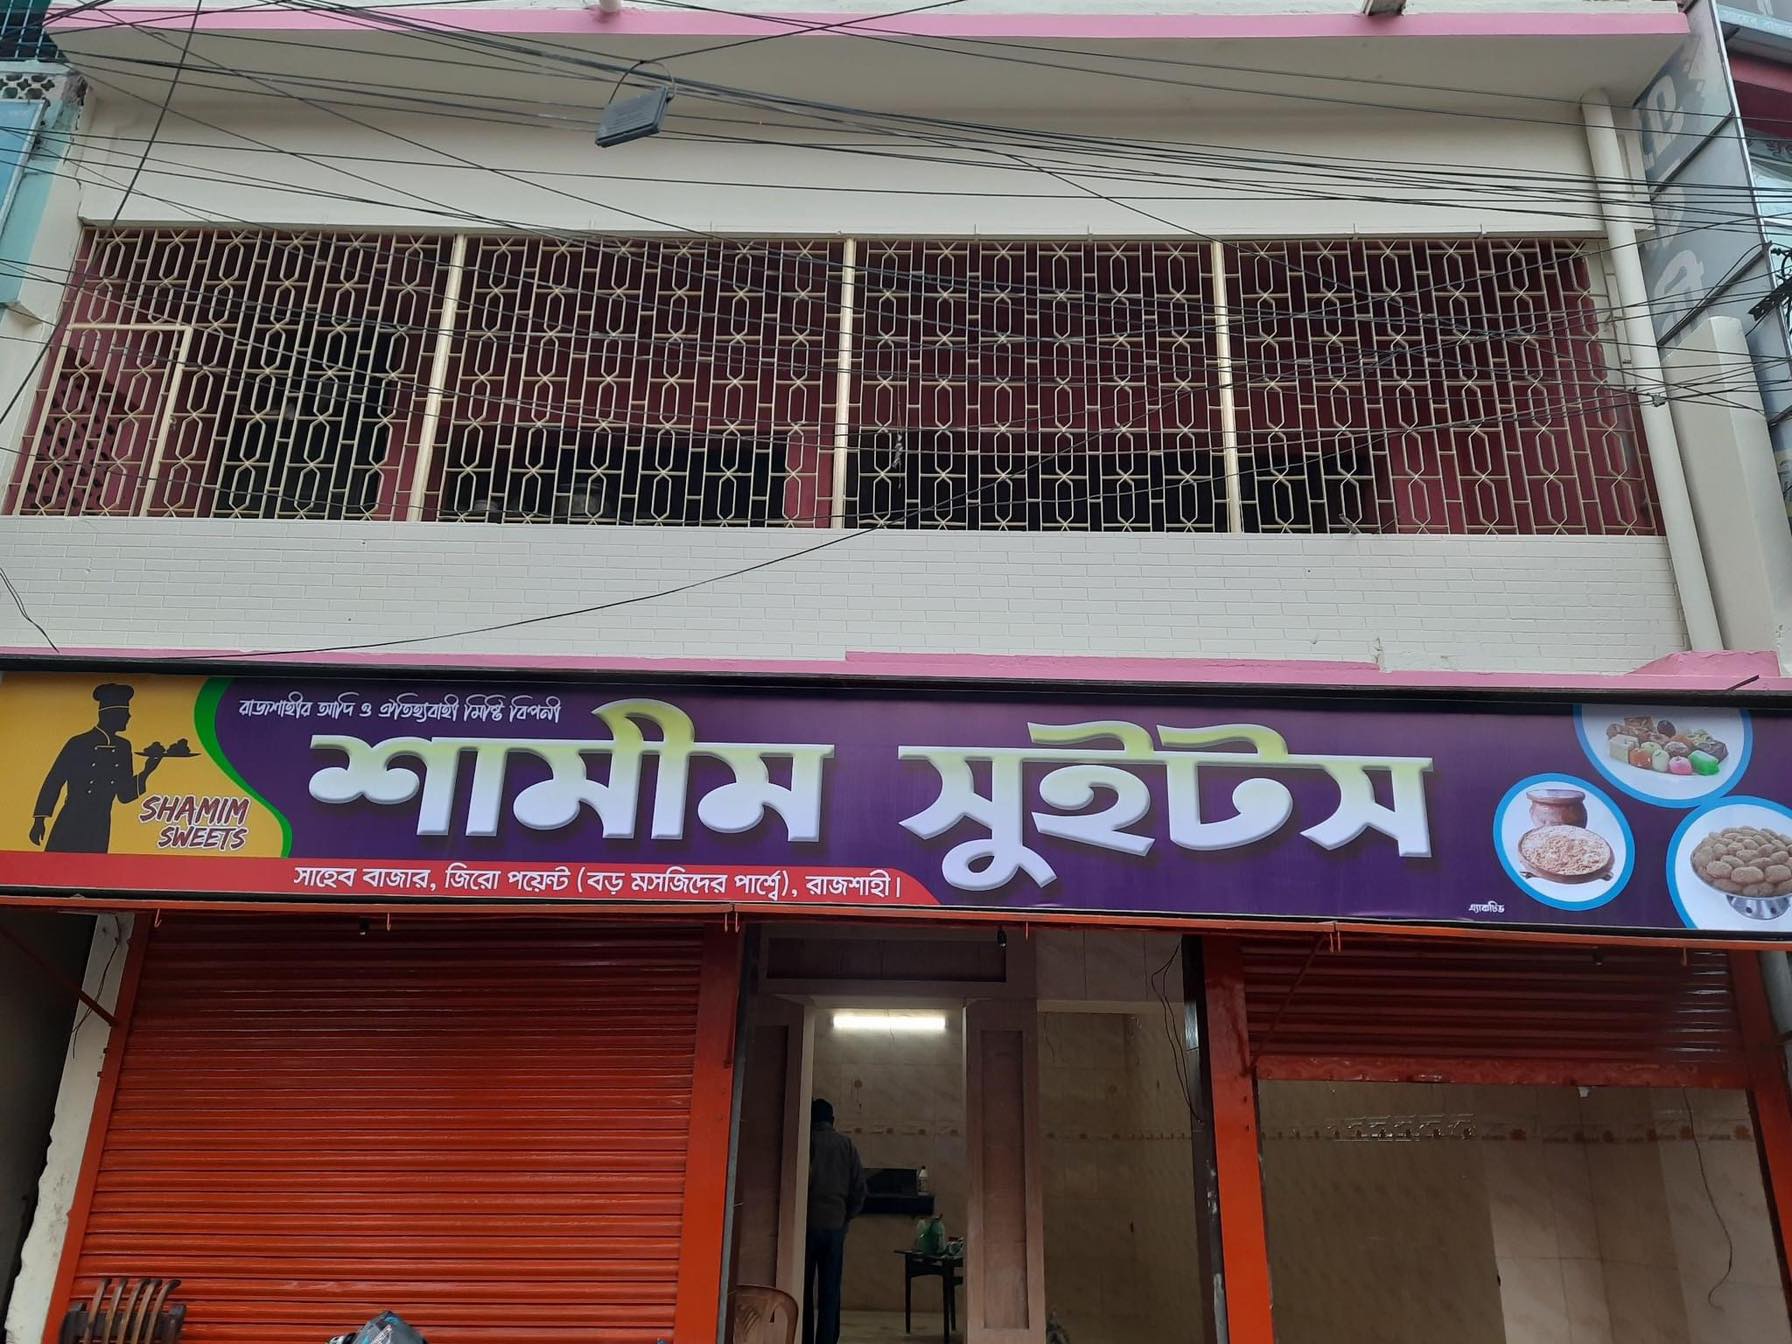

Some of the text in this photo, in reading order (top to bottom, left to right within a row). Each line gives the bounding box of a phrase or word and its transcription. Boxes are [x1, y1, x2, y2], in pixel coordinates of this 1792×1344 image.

[239, 691, 312, 719] রাজশাহীর
[317, 692, 359, 719] আদি
[360, 703, 372, 717] ও
[378, 693, 459, 723] ঐতিহ্যবাহী
[464, 695, 506, 722] মিষ্টি
[139, 795, 250, 826] SHAMIM
[308, 698, 1434, 891] শামীম সুইটস
[158, 825, 248, 852] SWEETS
[293, 867, 357, 888] সাহেব
[362, 868, 437, 890] বাজার,
[444, 862, 502, 890] জিরো
[508, 866, 571, 892] পয়েন্ট
[577, 866, 624, 895] (বড়
[631, 866, 728, 894] মসজিদের
